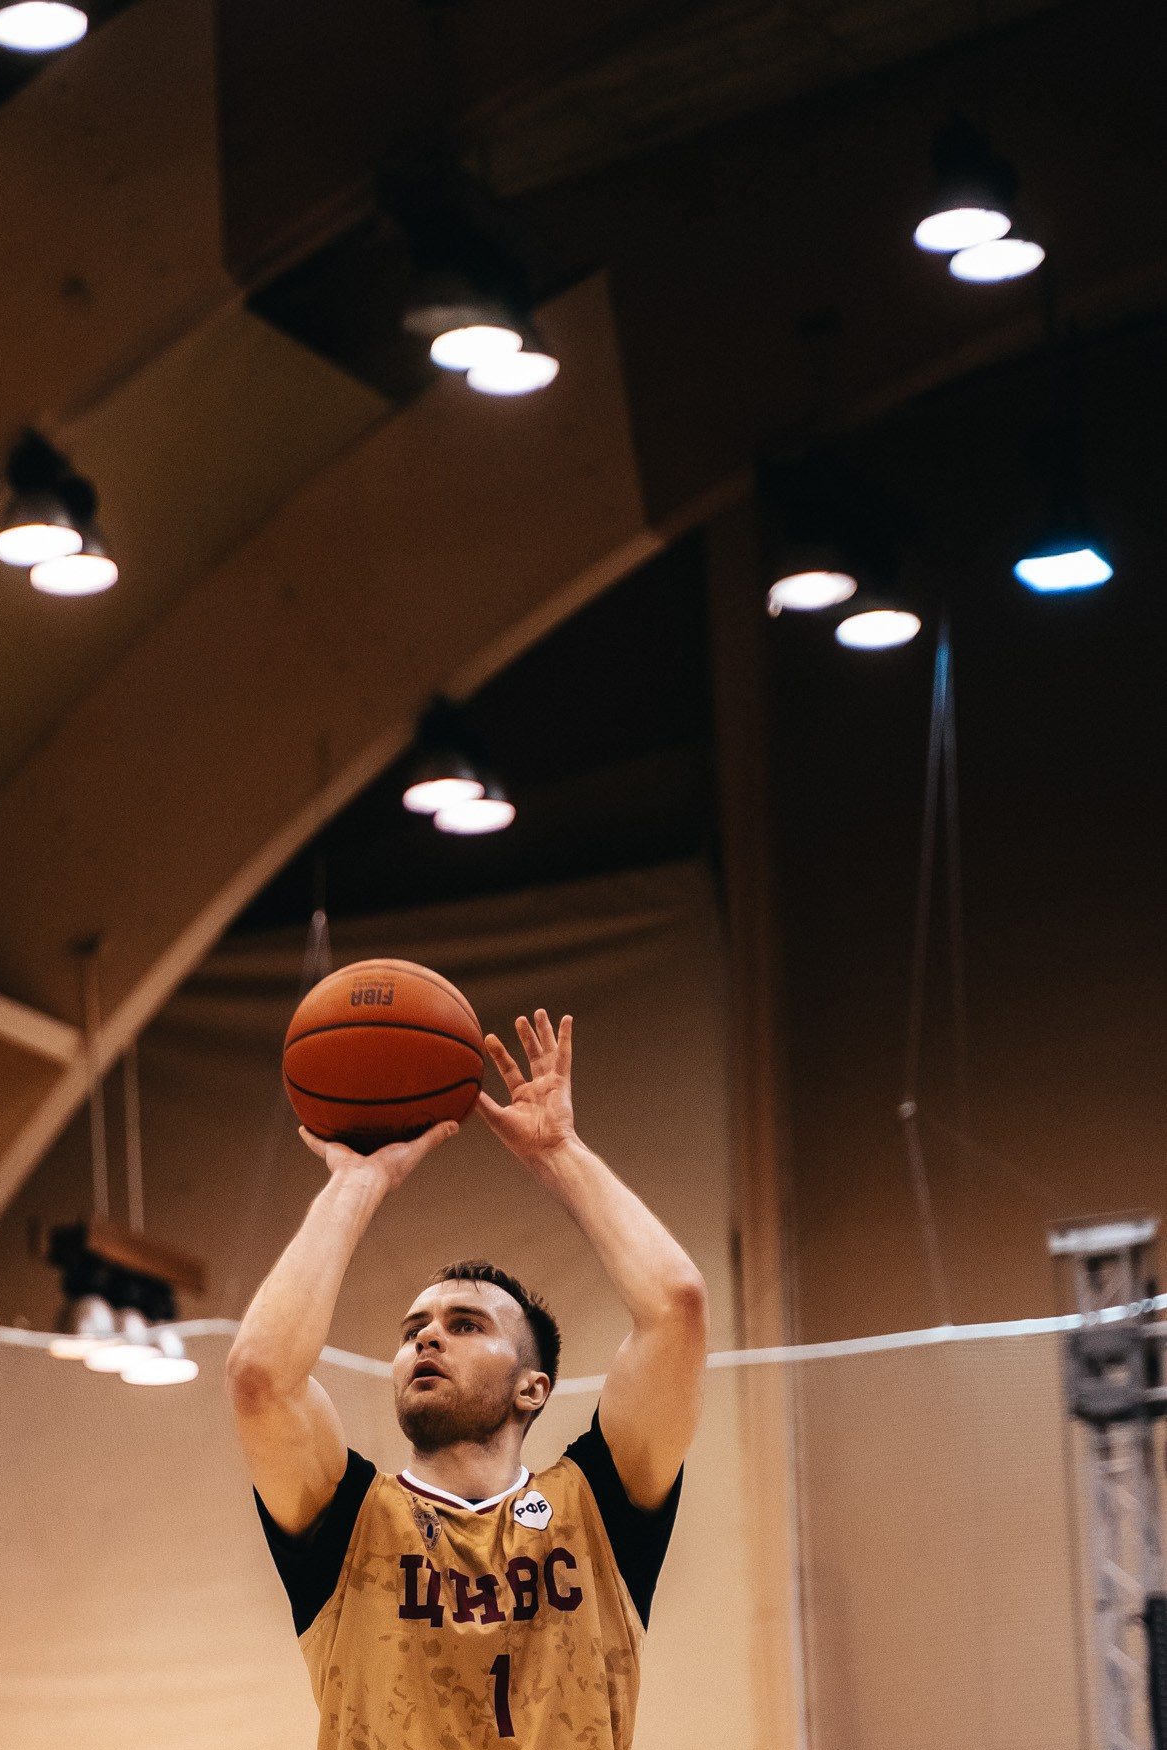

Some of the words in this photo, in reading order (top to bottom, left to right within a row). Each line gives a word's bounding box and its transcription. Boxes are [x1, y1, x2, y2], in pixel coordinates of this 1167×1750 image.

[351, 989, 394, 1006] FIBA
[515, 1499, 548, 1518] РФБ
[489, 1654, 516, 1738] 1
